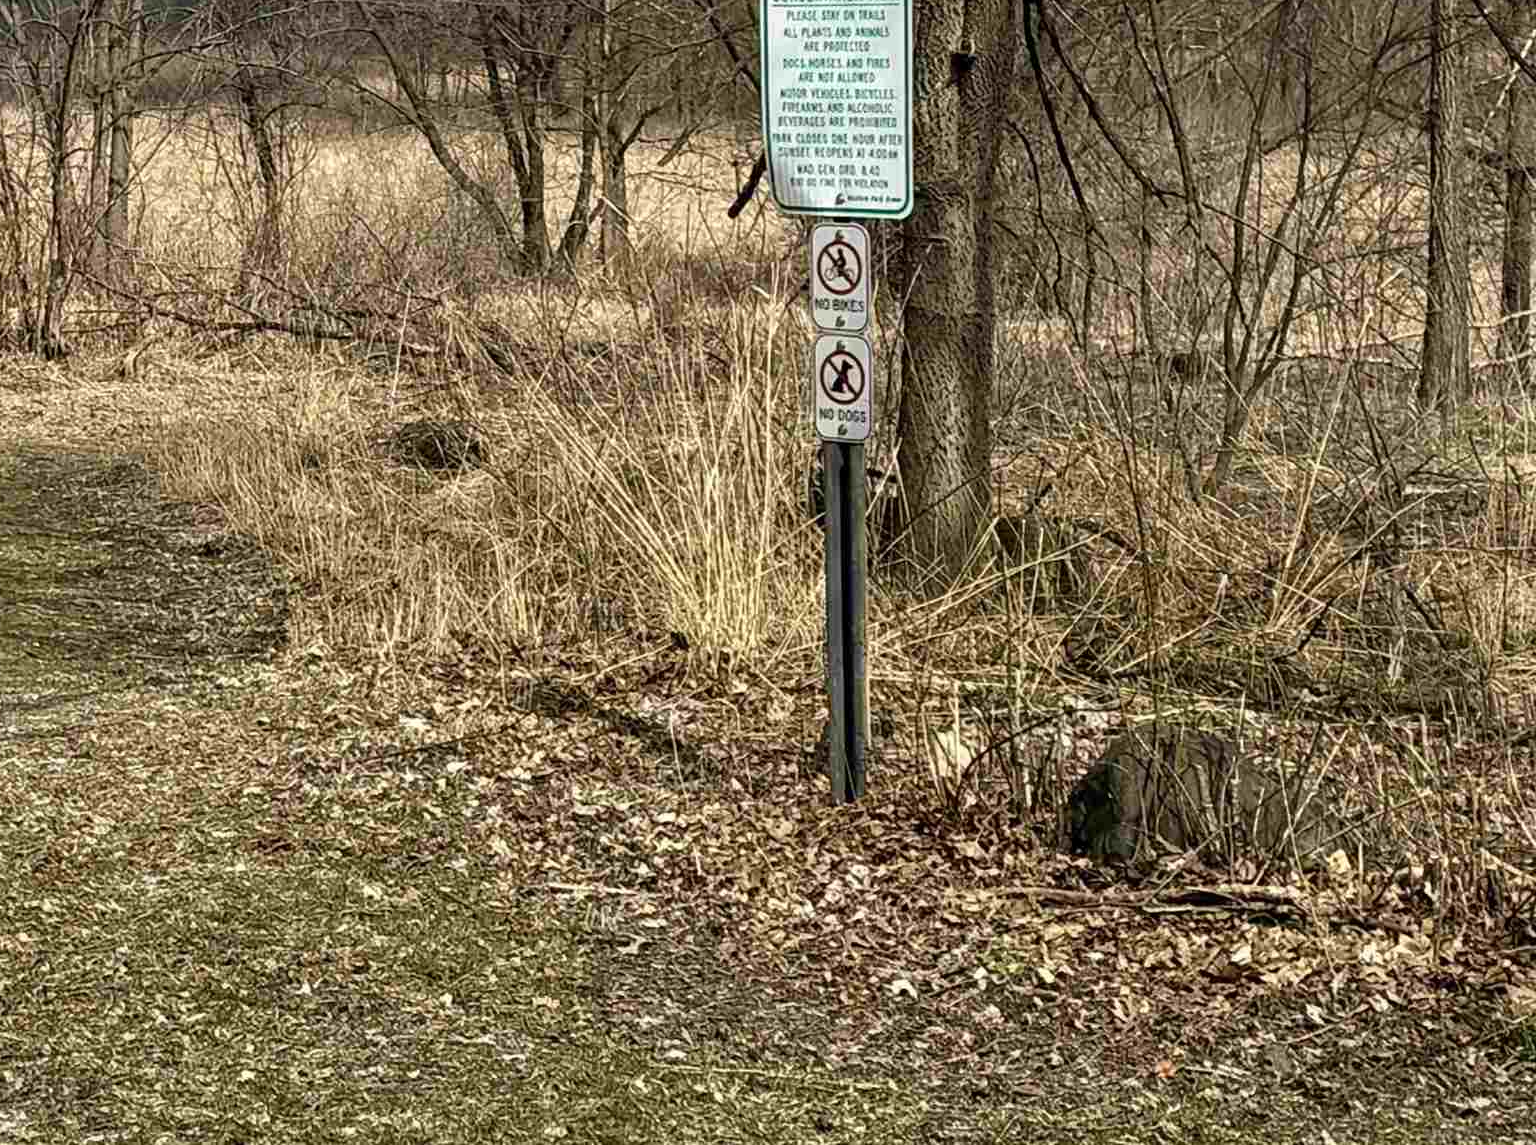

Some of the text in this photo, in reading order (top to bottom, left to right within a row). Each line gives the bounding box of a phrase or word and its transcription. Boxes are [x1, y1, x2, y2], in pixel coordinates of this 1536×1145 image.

[786, 9, 886, 22] PLEASE STAY ON TRAILS
[784, 26, 890, 39] ALL PLANTS AND ANIMALS
[803, 41, 871, 52] ARE PROTECTED
[846, 58, 863, 69] AND
[866, 57, 890, 69] FIRES
[798, 72, 876, 83] ARE NOT ALLOWED
[780, 88, 807, 99] MOTOR
[827, 102, 845, 113] AND
[847, 103, 894, 114] ALCOHOLIC
[778, 116, 897, 128] BEVERAGES ARE PROHIBITED
[772, 133, 903, 145] PARK CLOSES ONE HOUR AFTER
[814, 147, 853, 158] REOPENS
[856, 148, 867, 158] AT
[815, 298, 864, 313] NO BIKES
[819, 408, 866, 423] NO DOGS
